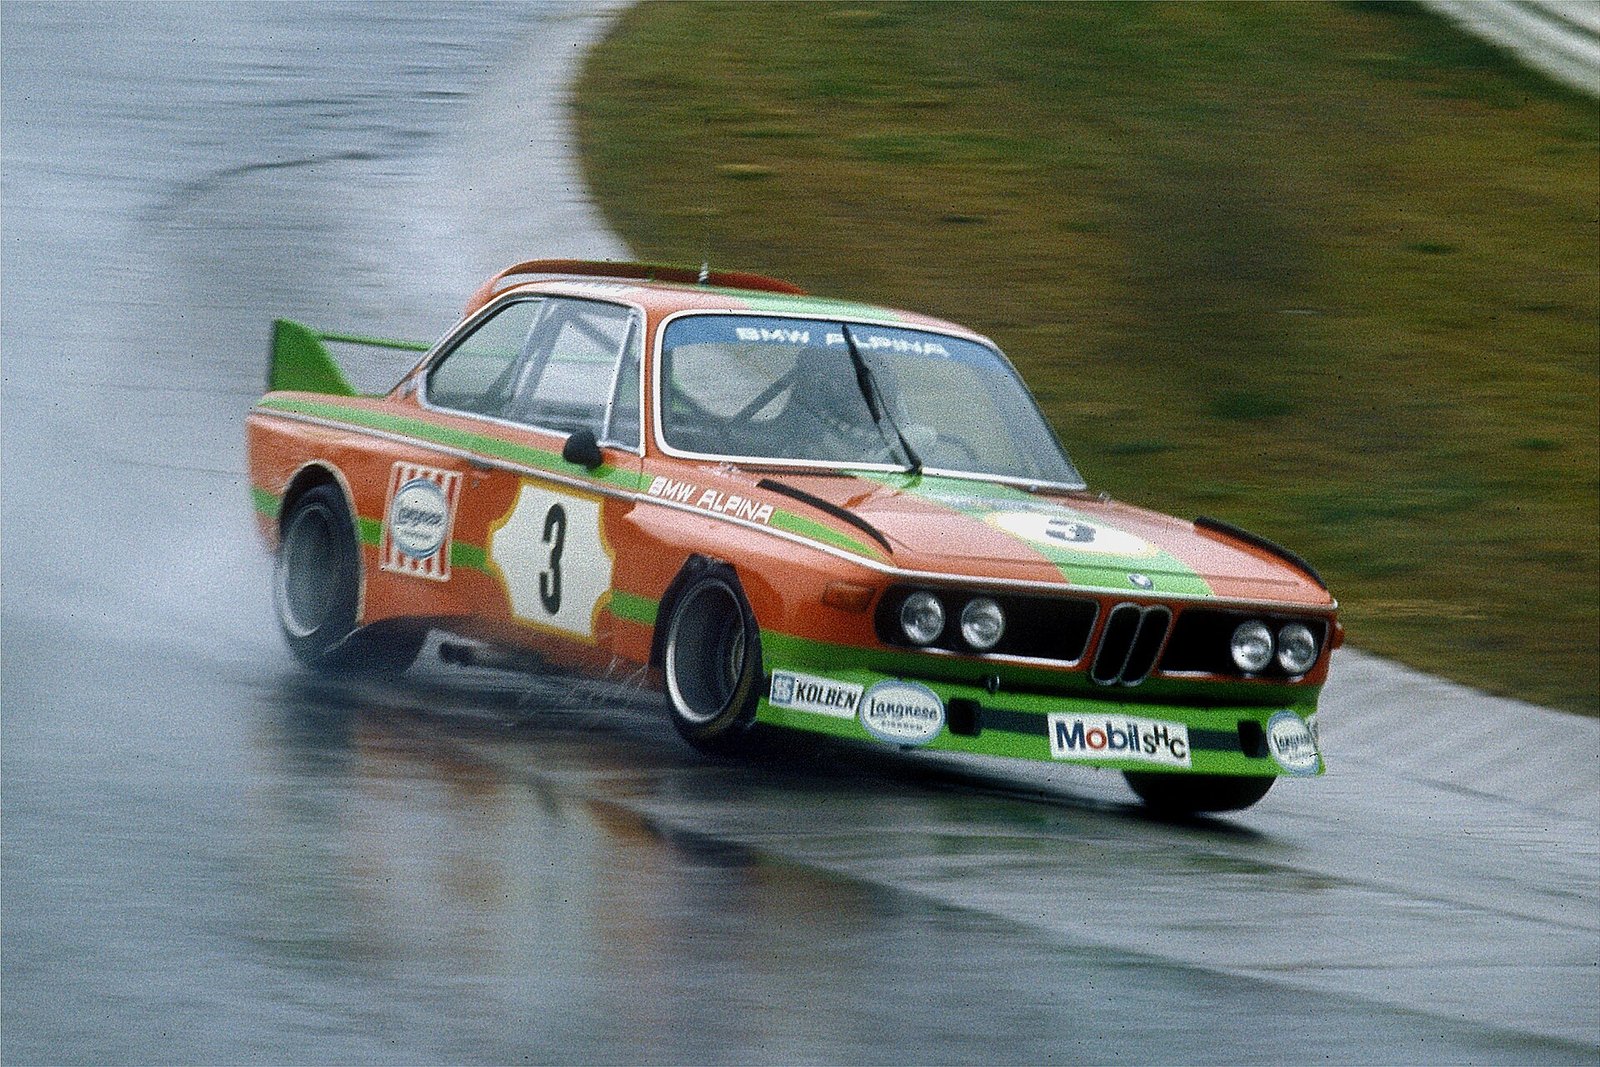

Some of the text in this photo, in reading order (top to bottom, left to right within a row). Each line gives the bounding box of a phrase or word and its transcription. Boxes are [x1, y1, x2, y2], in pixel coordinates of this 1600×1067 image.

[736, 327, 949, 358] BMW ALPINA
[648, 475, 774, 525] BMW ALPINA
[1045, 518, 1097, 543] 3
[539, 503, 567, 616] 3
[796, 682, 857, 710] KOLBEN
[870, 698, 938, 721] Langnese
[1055, 720, 1141, 752] Mobil
